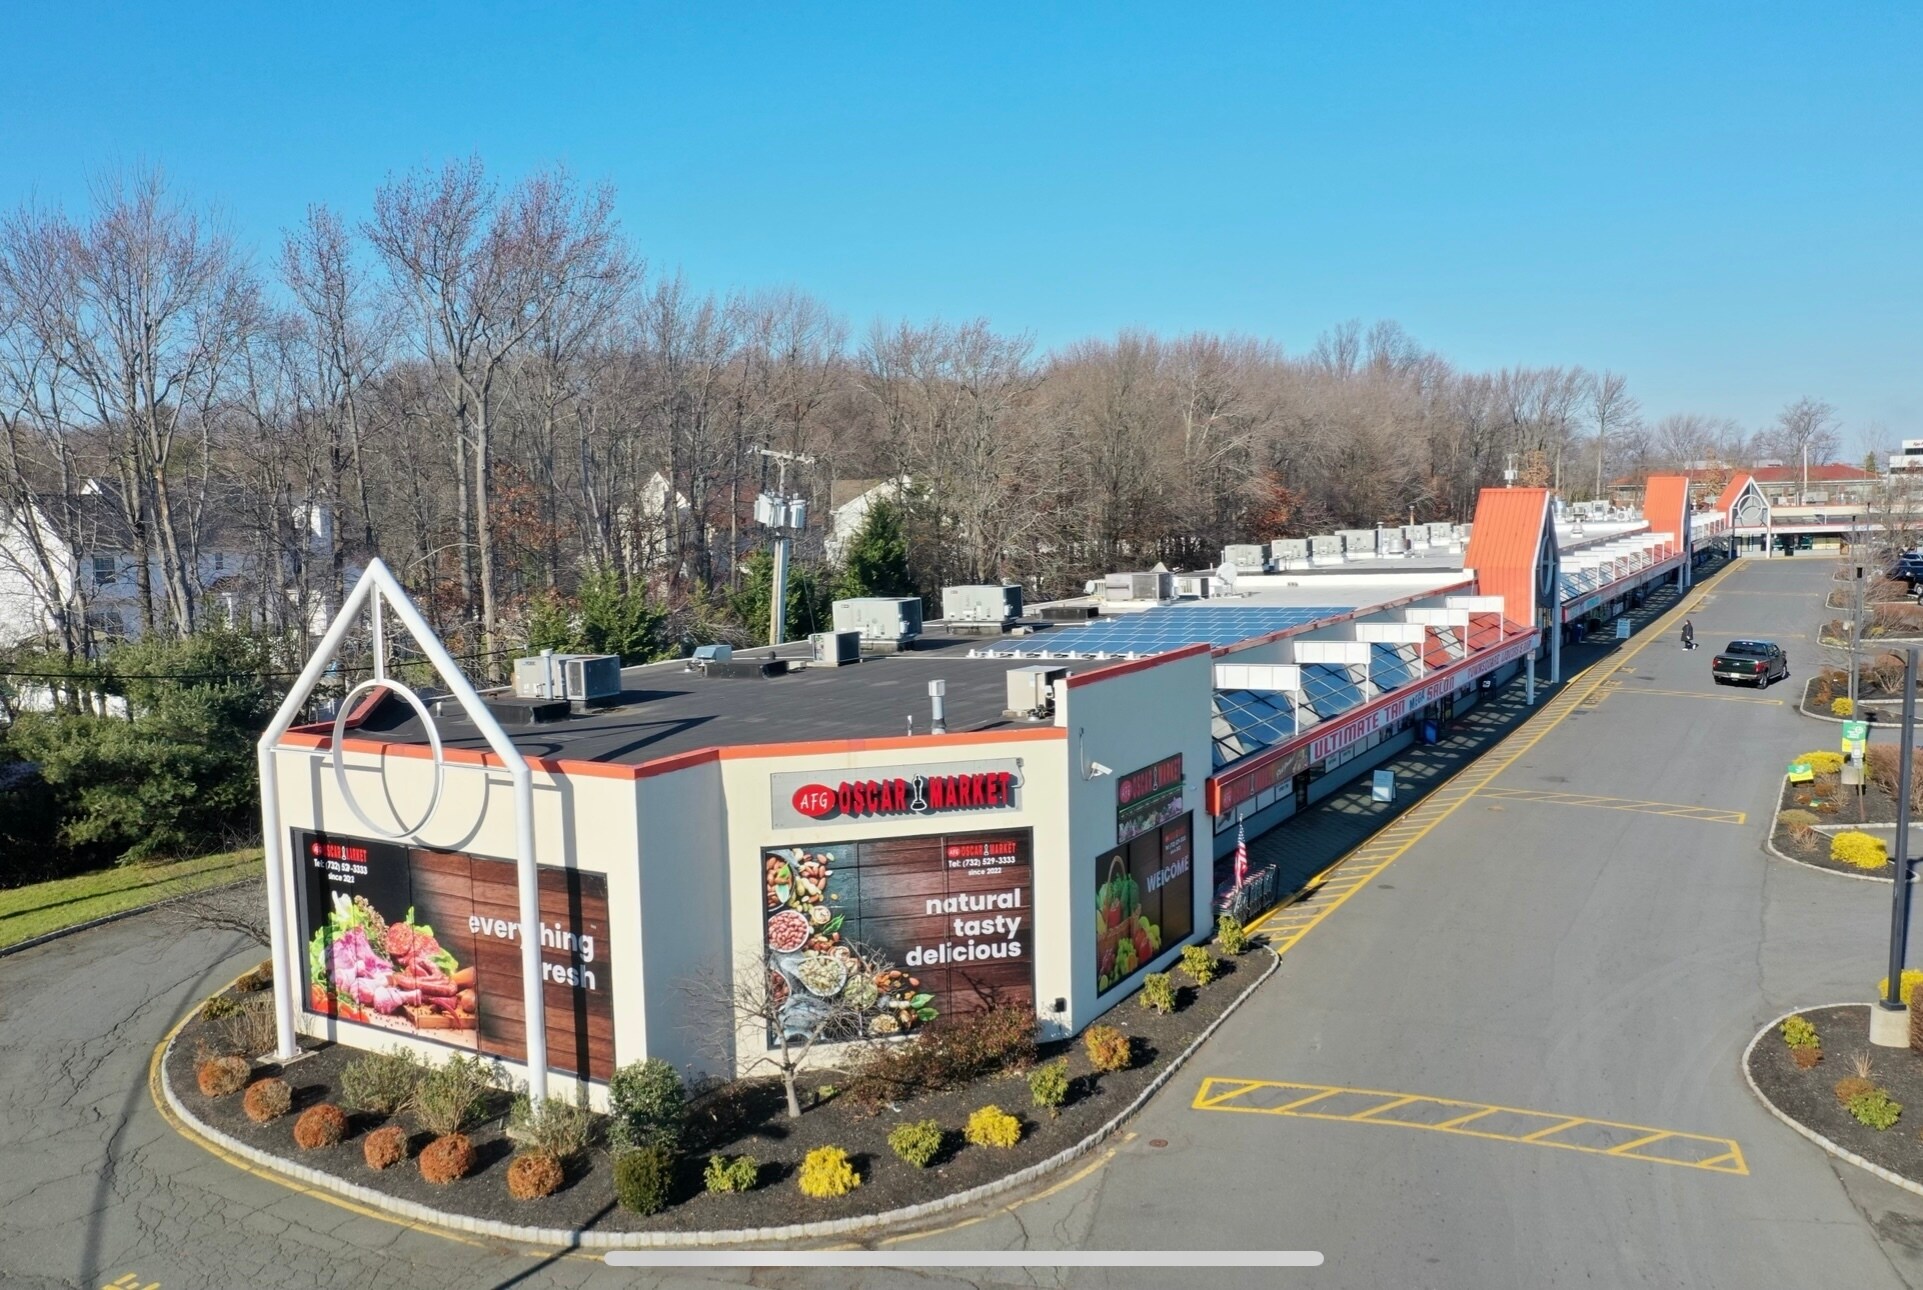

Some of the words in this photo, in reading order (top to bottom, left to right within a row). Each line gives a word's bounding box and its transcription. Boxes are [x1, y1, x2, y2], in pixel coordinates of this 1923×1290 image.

[1314, 712, 1379, 760] ULTIMATE
[1384, 700, 1405, 722] TAN
[1427, 676, 1455, 701] SALON
[800, 791, 828, 809] AFG
[838, 778, 906, 815] OSCAR
[929, 772, 1010, 809] MARKET
[962, 858, 981, 868] (732)
[982, 856, 1016, 865] 529-3333
[926, 888, 1021, 915] natural
[953, 915, 1022, 939] tasty
[906, 940, 1022, 966] delicious
[540, 962, 596, 990] resh
